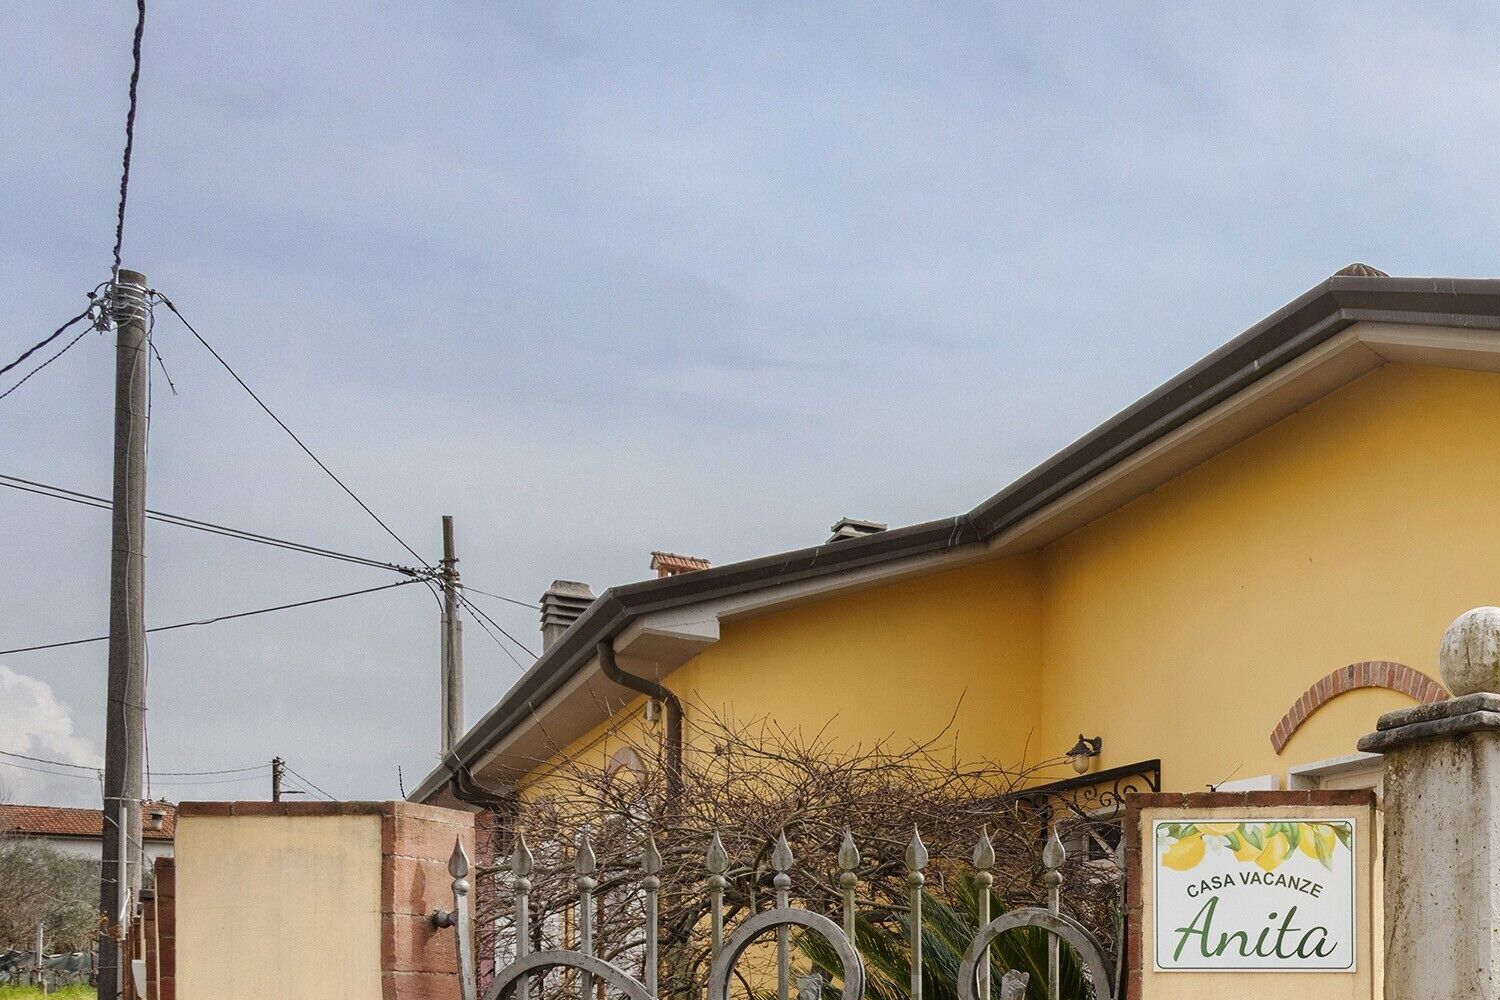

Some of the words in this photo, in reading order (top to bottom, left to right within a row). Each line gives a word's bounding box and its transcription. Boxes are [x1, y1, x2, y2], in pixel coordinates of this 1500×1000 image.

[1186, 873, 1236, 898] CASA
[1238, 872, 1324, 898] VACANZE
[1173, 896, 1338, 962] Anita
